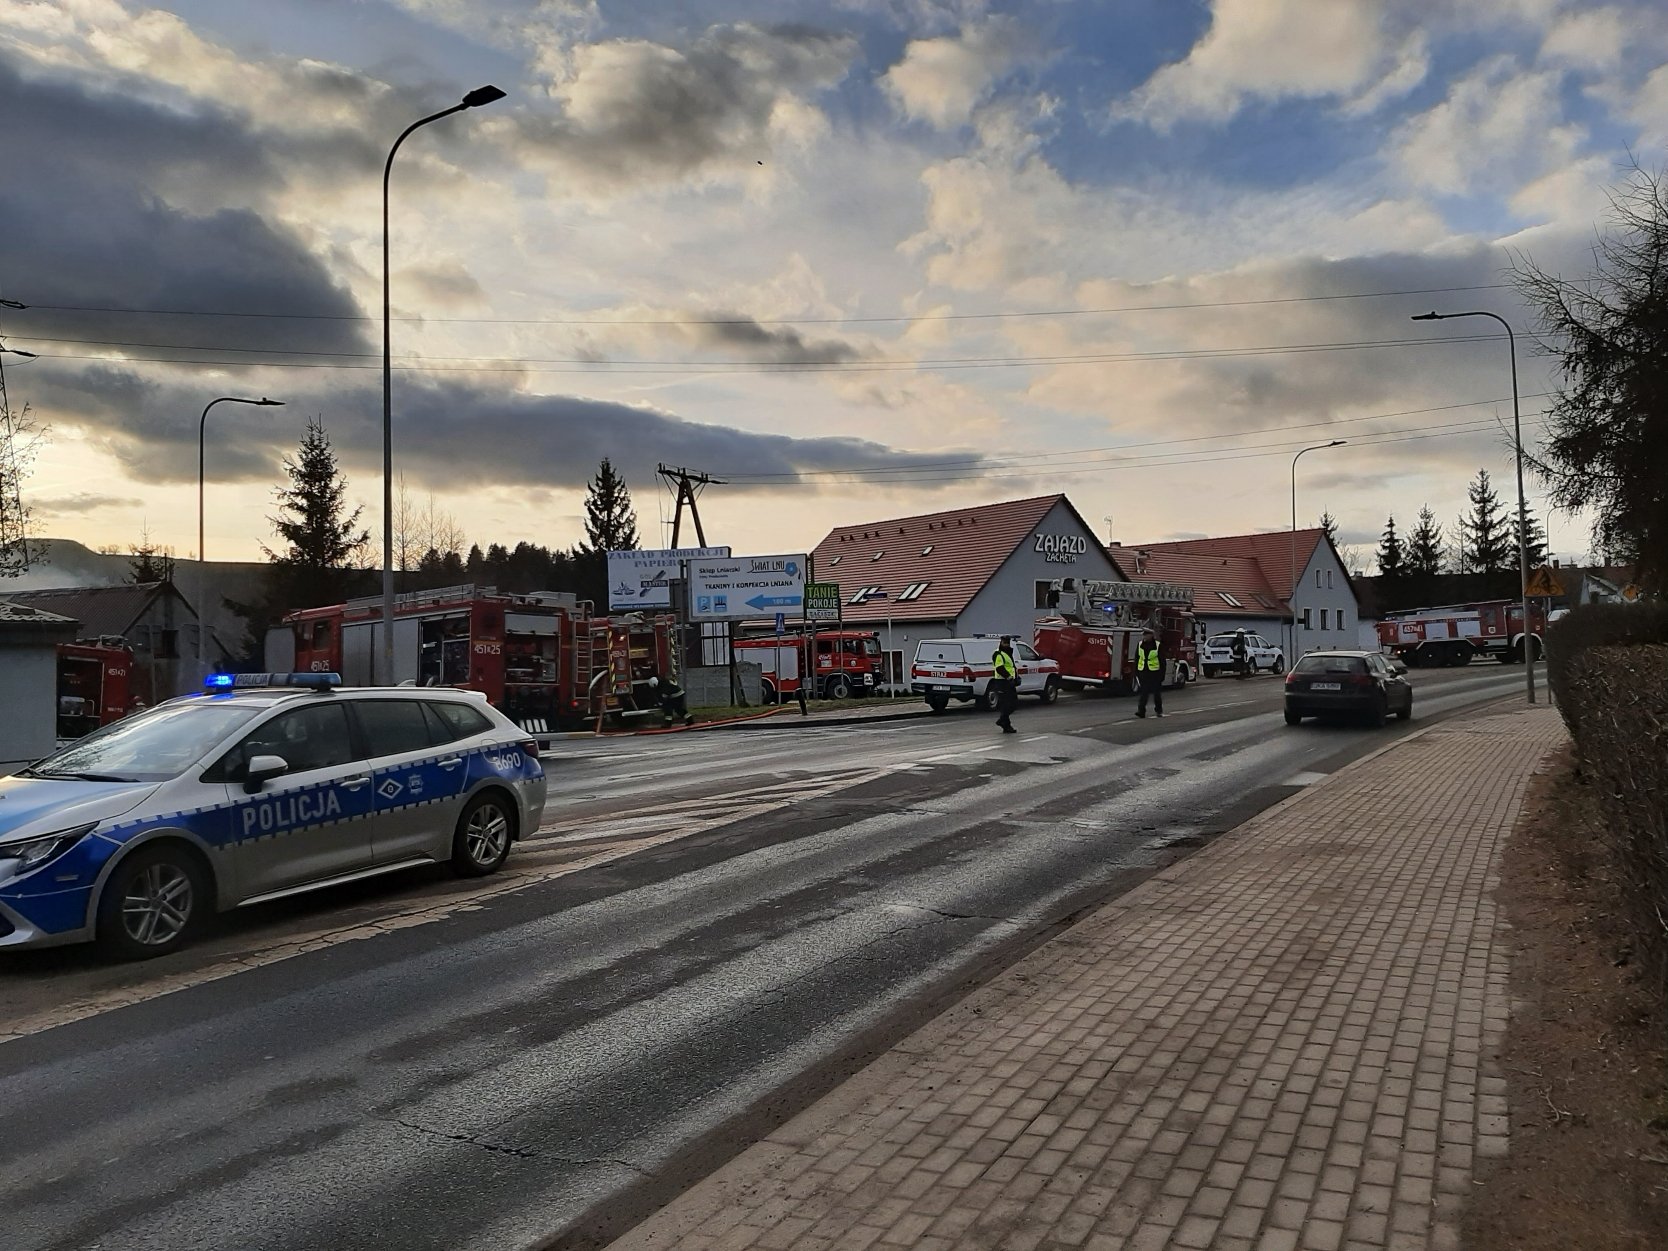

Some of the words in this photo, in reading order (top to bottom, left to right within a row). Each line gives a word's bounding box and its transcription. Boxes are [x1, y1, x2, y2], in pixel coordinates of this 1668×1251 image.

[1034, 534, 1087, 554] ZAJAZD
[661, 548, 724, 558] PRODUKCJI
[736, 581, 769, 589] KONFEKCJA
[807, 586, 838, 598] TANIE
[808, 598, 838, 608] POKOJE
[237, 673, 269, 685] POLICJA
[242, 789, 342, 835] POLICJA
